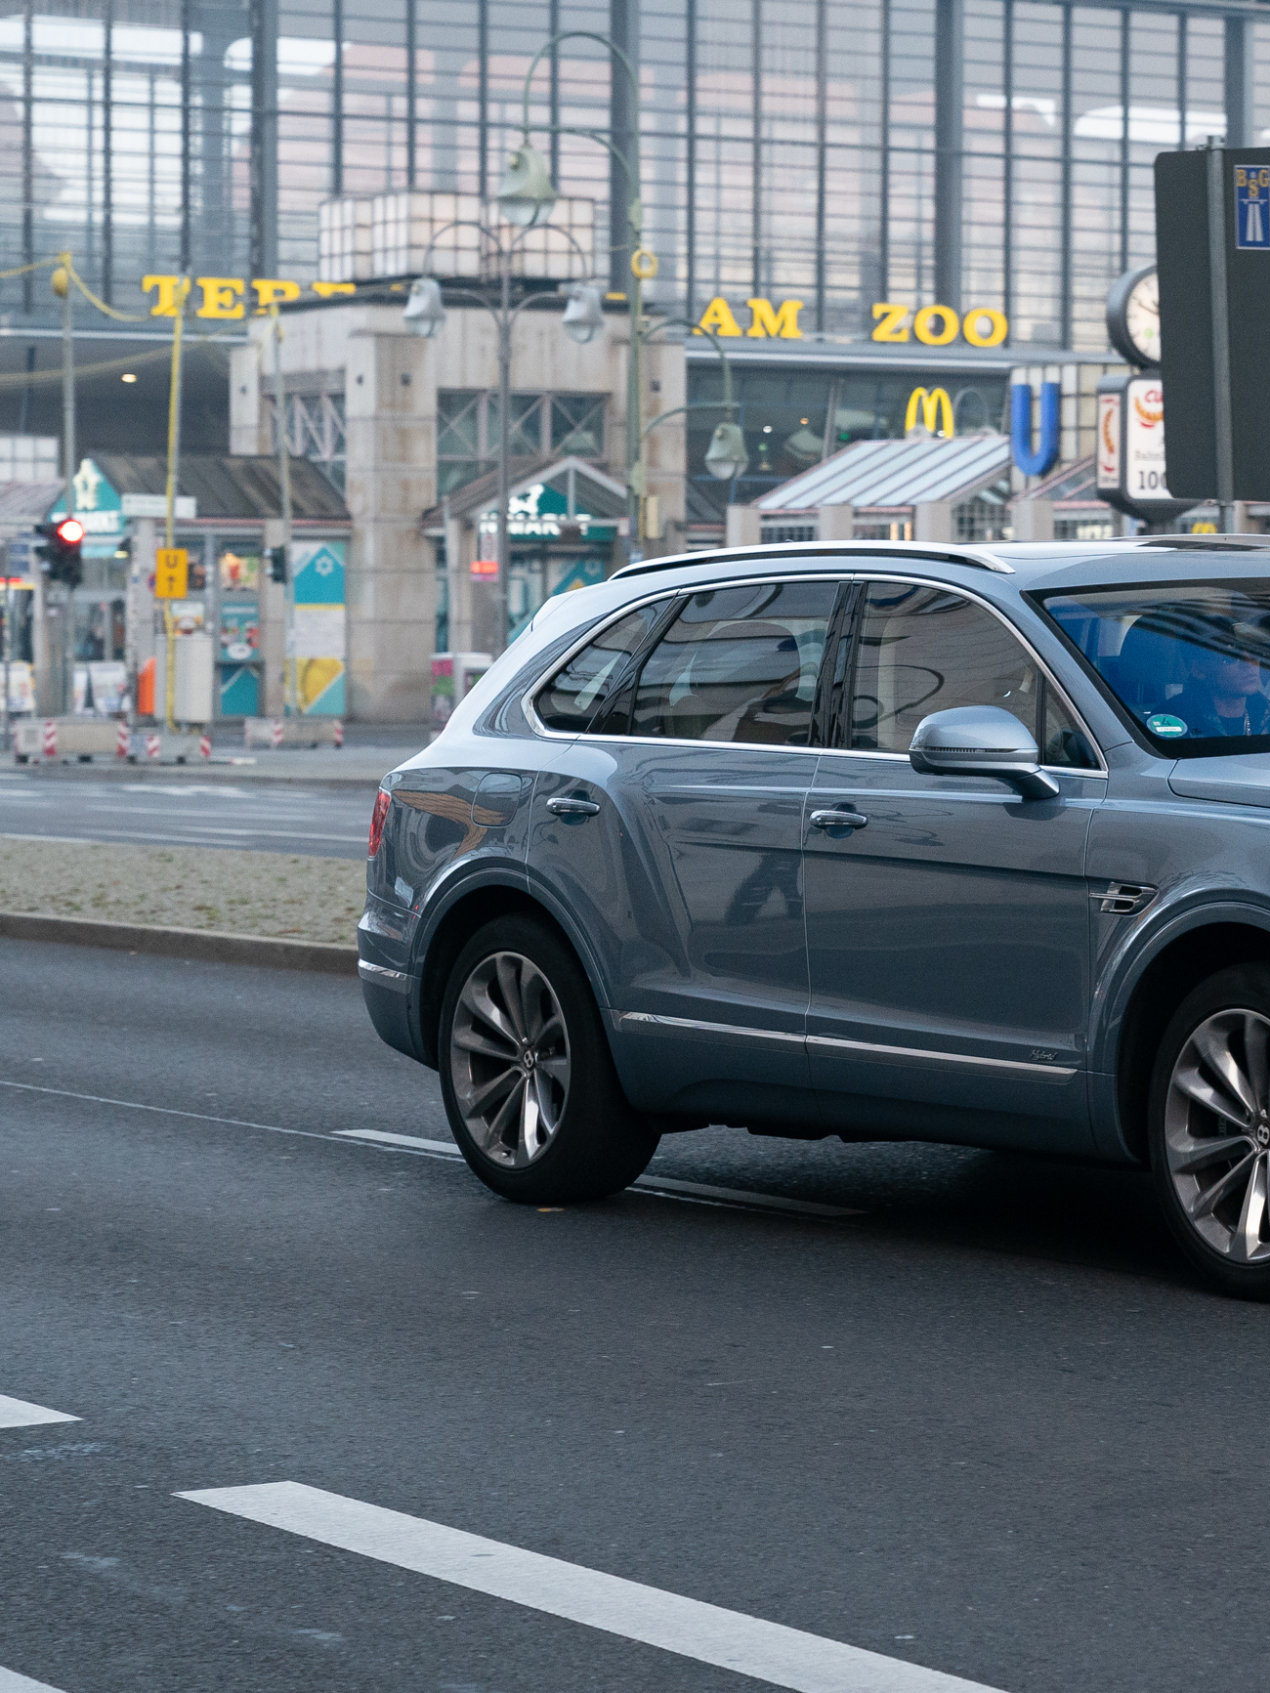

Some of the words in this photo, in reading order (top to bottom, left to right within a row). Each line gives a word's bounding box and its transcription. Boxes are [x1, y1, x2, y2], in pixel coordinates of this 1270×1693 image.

[693, 297, 803, 339] AM
[872, 303, 1008, 347] ZOO
[1011, 382, 1062, 477] U
